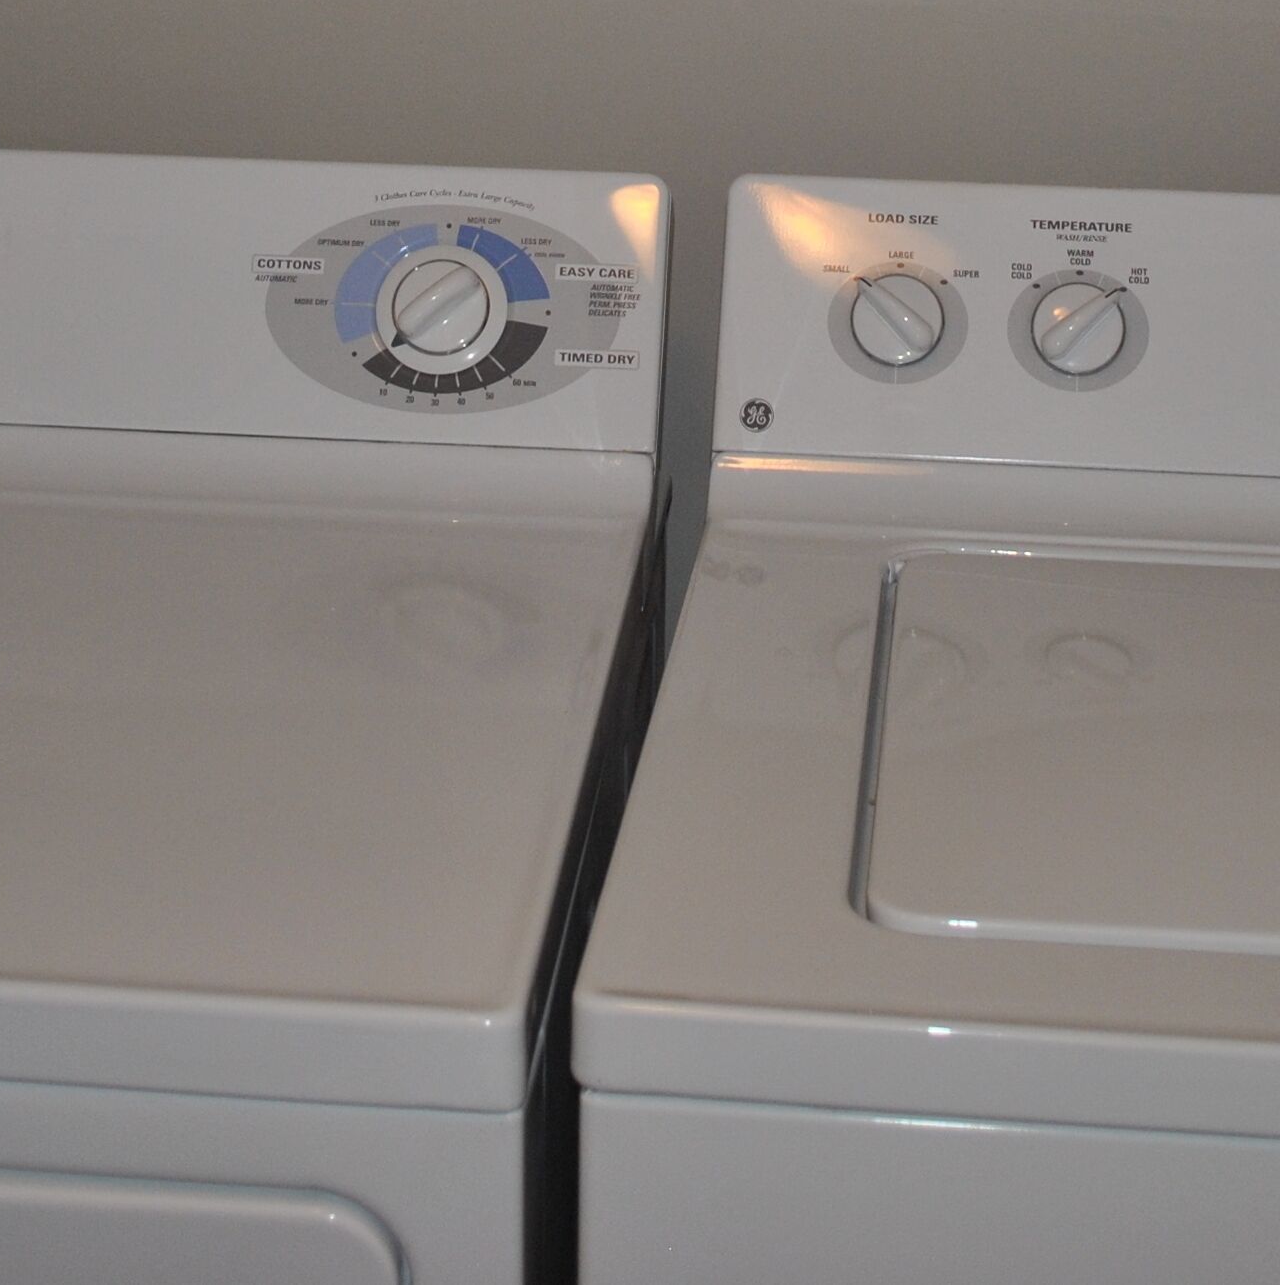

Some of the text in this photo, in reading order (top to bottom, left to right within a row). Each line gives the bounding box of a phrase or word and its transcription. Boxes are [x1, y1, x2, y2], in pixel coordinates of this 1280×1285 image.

[380, 192, 407, 201] Clothes
[409, 190, 427, 198] Care
[429, 189, 452, 198] Cycles
[458, 190, 478, 199] Extra
[480, 192, 502, 203] Large
[503, 195, 535, 211] Capacity
[869, 213, 939, 225] LOAD SIZE
[1031, 219, 1133, 233] TEMPERATURE
[317, 238, 350, 246] OPTIMUM
[538, 238, 552, 246] DRY
[1056, 234, 1108, 243] WASH/RINSE
[888, 251, 915, 260] LARGE
[1067, 249, 1094, 258] WARM
[257, 258, 322, 271] COTTONS
[1070, 258, 1091, 266] COLD
[823, 265, 851, 273] SMALL
[1011, 263, 1032, 272] COLD
[1131, 267, 1148, 276] HOT
[560, 266, 635, 279] EASY CARE
[953, 269, 980, 279] SUPER
[1011, 271, 1032, 280] COLD
[255, 274, 298, 283] AUTOMATIC
[1129, 276, 1150, 285] COLD
[591, 284, 634, 292] AUTOMATIC
[623, 293, 640, 301] FREE
[613, 301, 636, 309] PRESS
[588, 309, 627, 317] DELICATES
[559, 352, 635, 365] TIMED DRY
[512, 378, 522, 386] 60
[379, 388, 388, 396] 10
[485, 392, 494, 400] 50
[405, 395, 415, 403] 20
[431, 398, 440, 407] 30
[457, 397, 466, 406] 40
